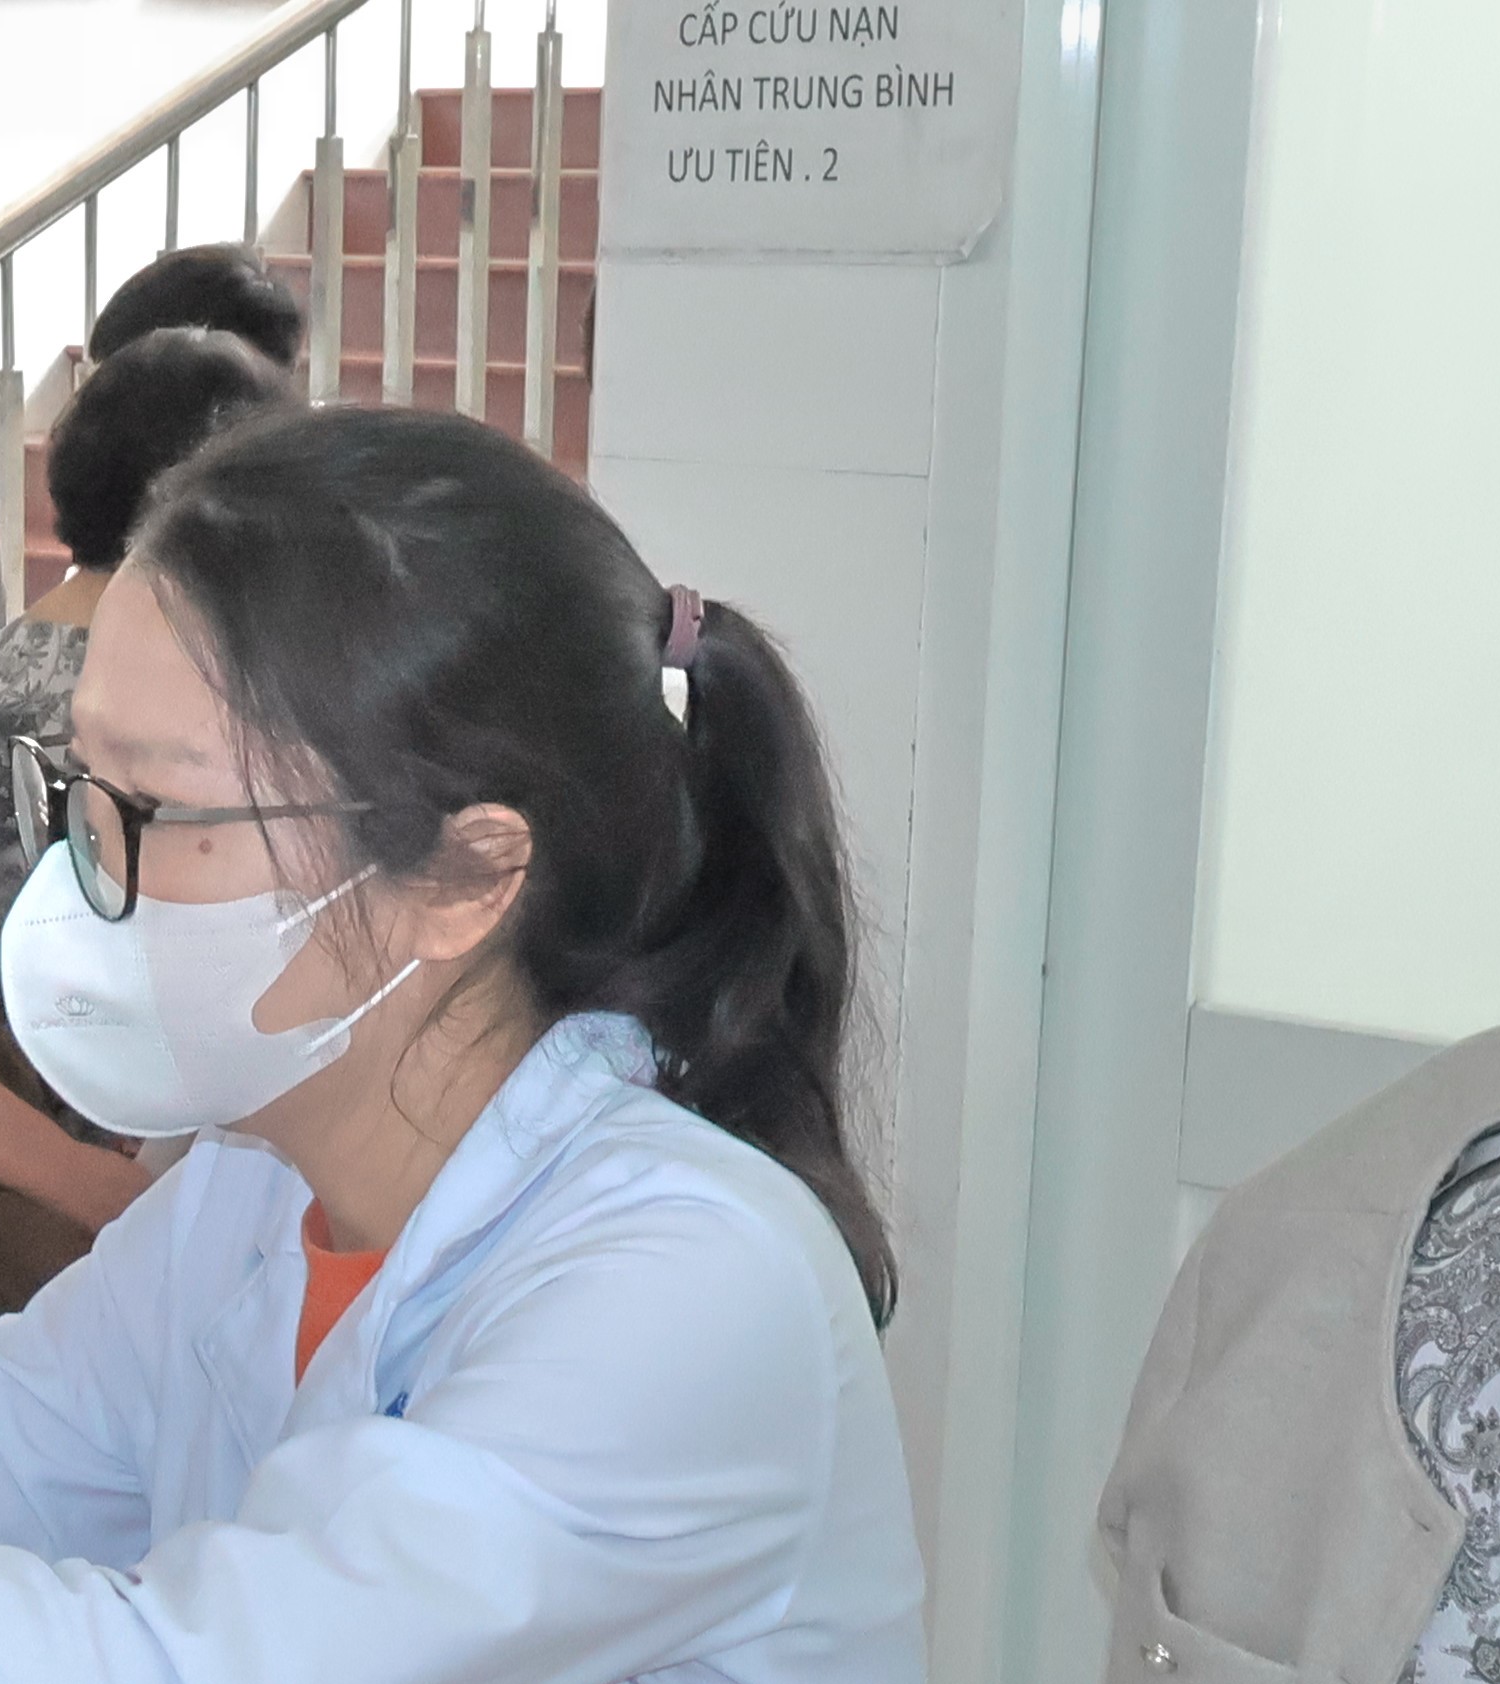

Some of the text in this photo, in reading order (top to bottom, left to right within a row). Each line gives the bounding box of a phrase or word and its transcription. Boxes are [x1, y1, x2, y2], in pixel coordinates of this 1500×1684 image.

[679, 0, 900, 48] CẤP CỨU NẠN
[654, 65, 956, 113] NHÂN TRUNG BÌNH
[668, 147, 715, 183] ƯU
[726, 139, 793, 183] TIÊN
[822, 148, 839, 182] 2
